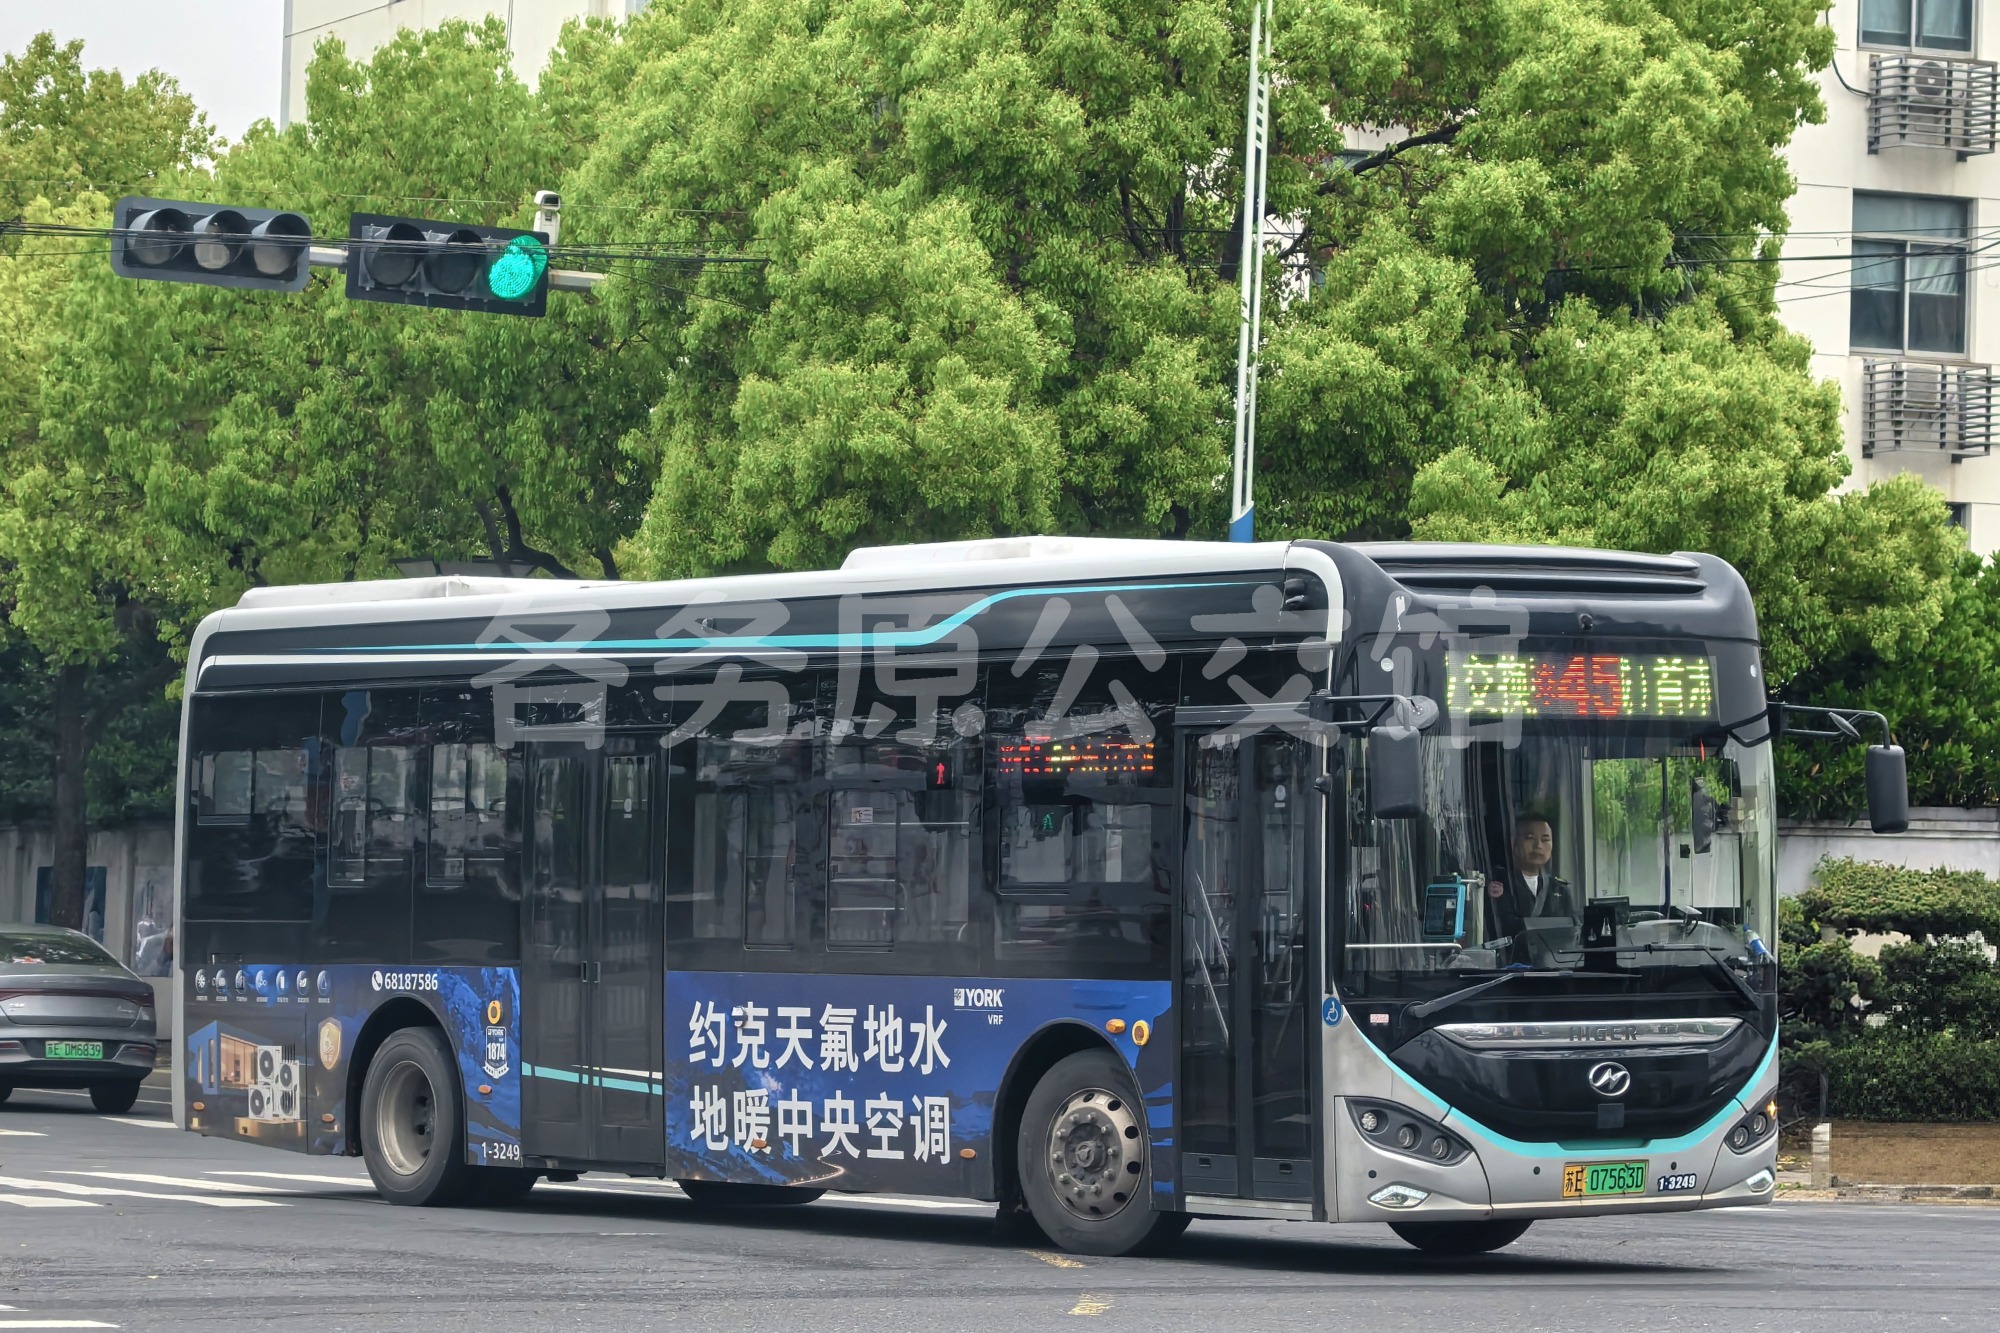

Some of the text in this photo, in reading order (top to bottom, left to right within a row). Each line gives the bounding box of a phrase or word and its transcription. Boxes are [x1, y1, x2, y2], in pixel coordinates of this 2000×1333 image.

[384, 972, 438, 991] 68187586
[965, 988, 1003, 1007] YORK
[987, 1014, 1004, 1025] VRF
[688, 1000, 951, 1075] 约克天氟地水
[1569, 1023, 1638, 1042] HIGER
[487, 1042, 505, 1060] 1874
[689, 1084, 951, 1165] 地暖中央空调
[481, 1141, 520, 1161] 1-3249
